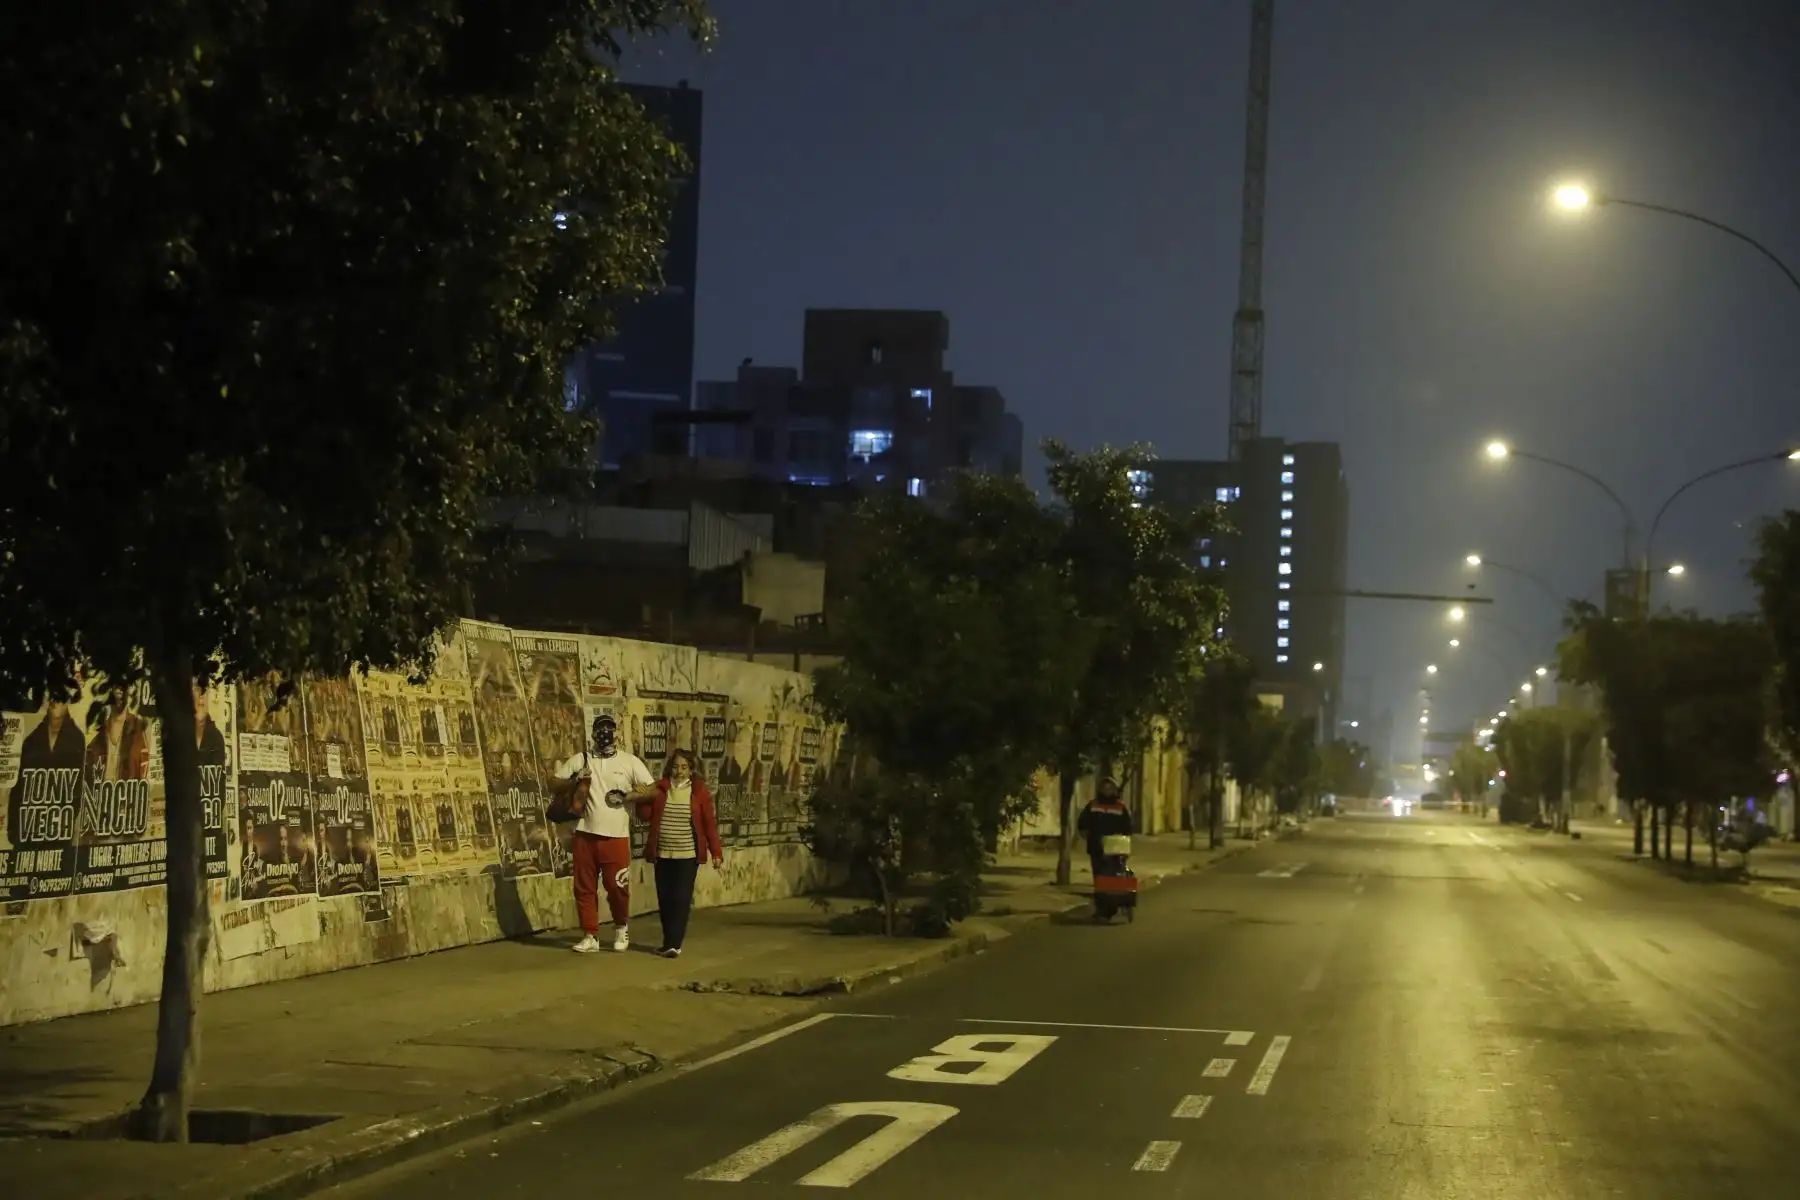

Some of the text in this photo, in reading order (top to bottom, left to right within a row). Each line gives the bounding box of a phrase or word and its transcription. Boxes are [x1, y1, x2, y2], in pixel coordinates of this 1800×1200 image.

[22, 768, 80, 805] TONY
[198, 764, 223, 797] NY
[81, 779, 150, 837] NACHO
[199, 797, 223, 830] GA
[269, 779, 287, 822] 02
[285, 786, 302, 807] JULIO
[336, 785, 353, 824] 02
[508, 787, 524, 820] 02
[19, 805, 75, 842] VEGA
[15, 850, 36, 874] LIMA
[36, 848, 64, 873] NORTE
